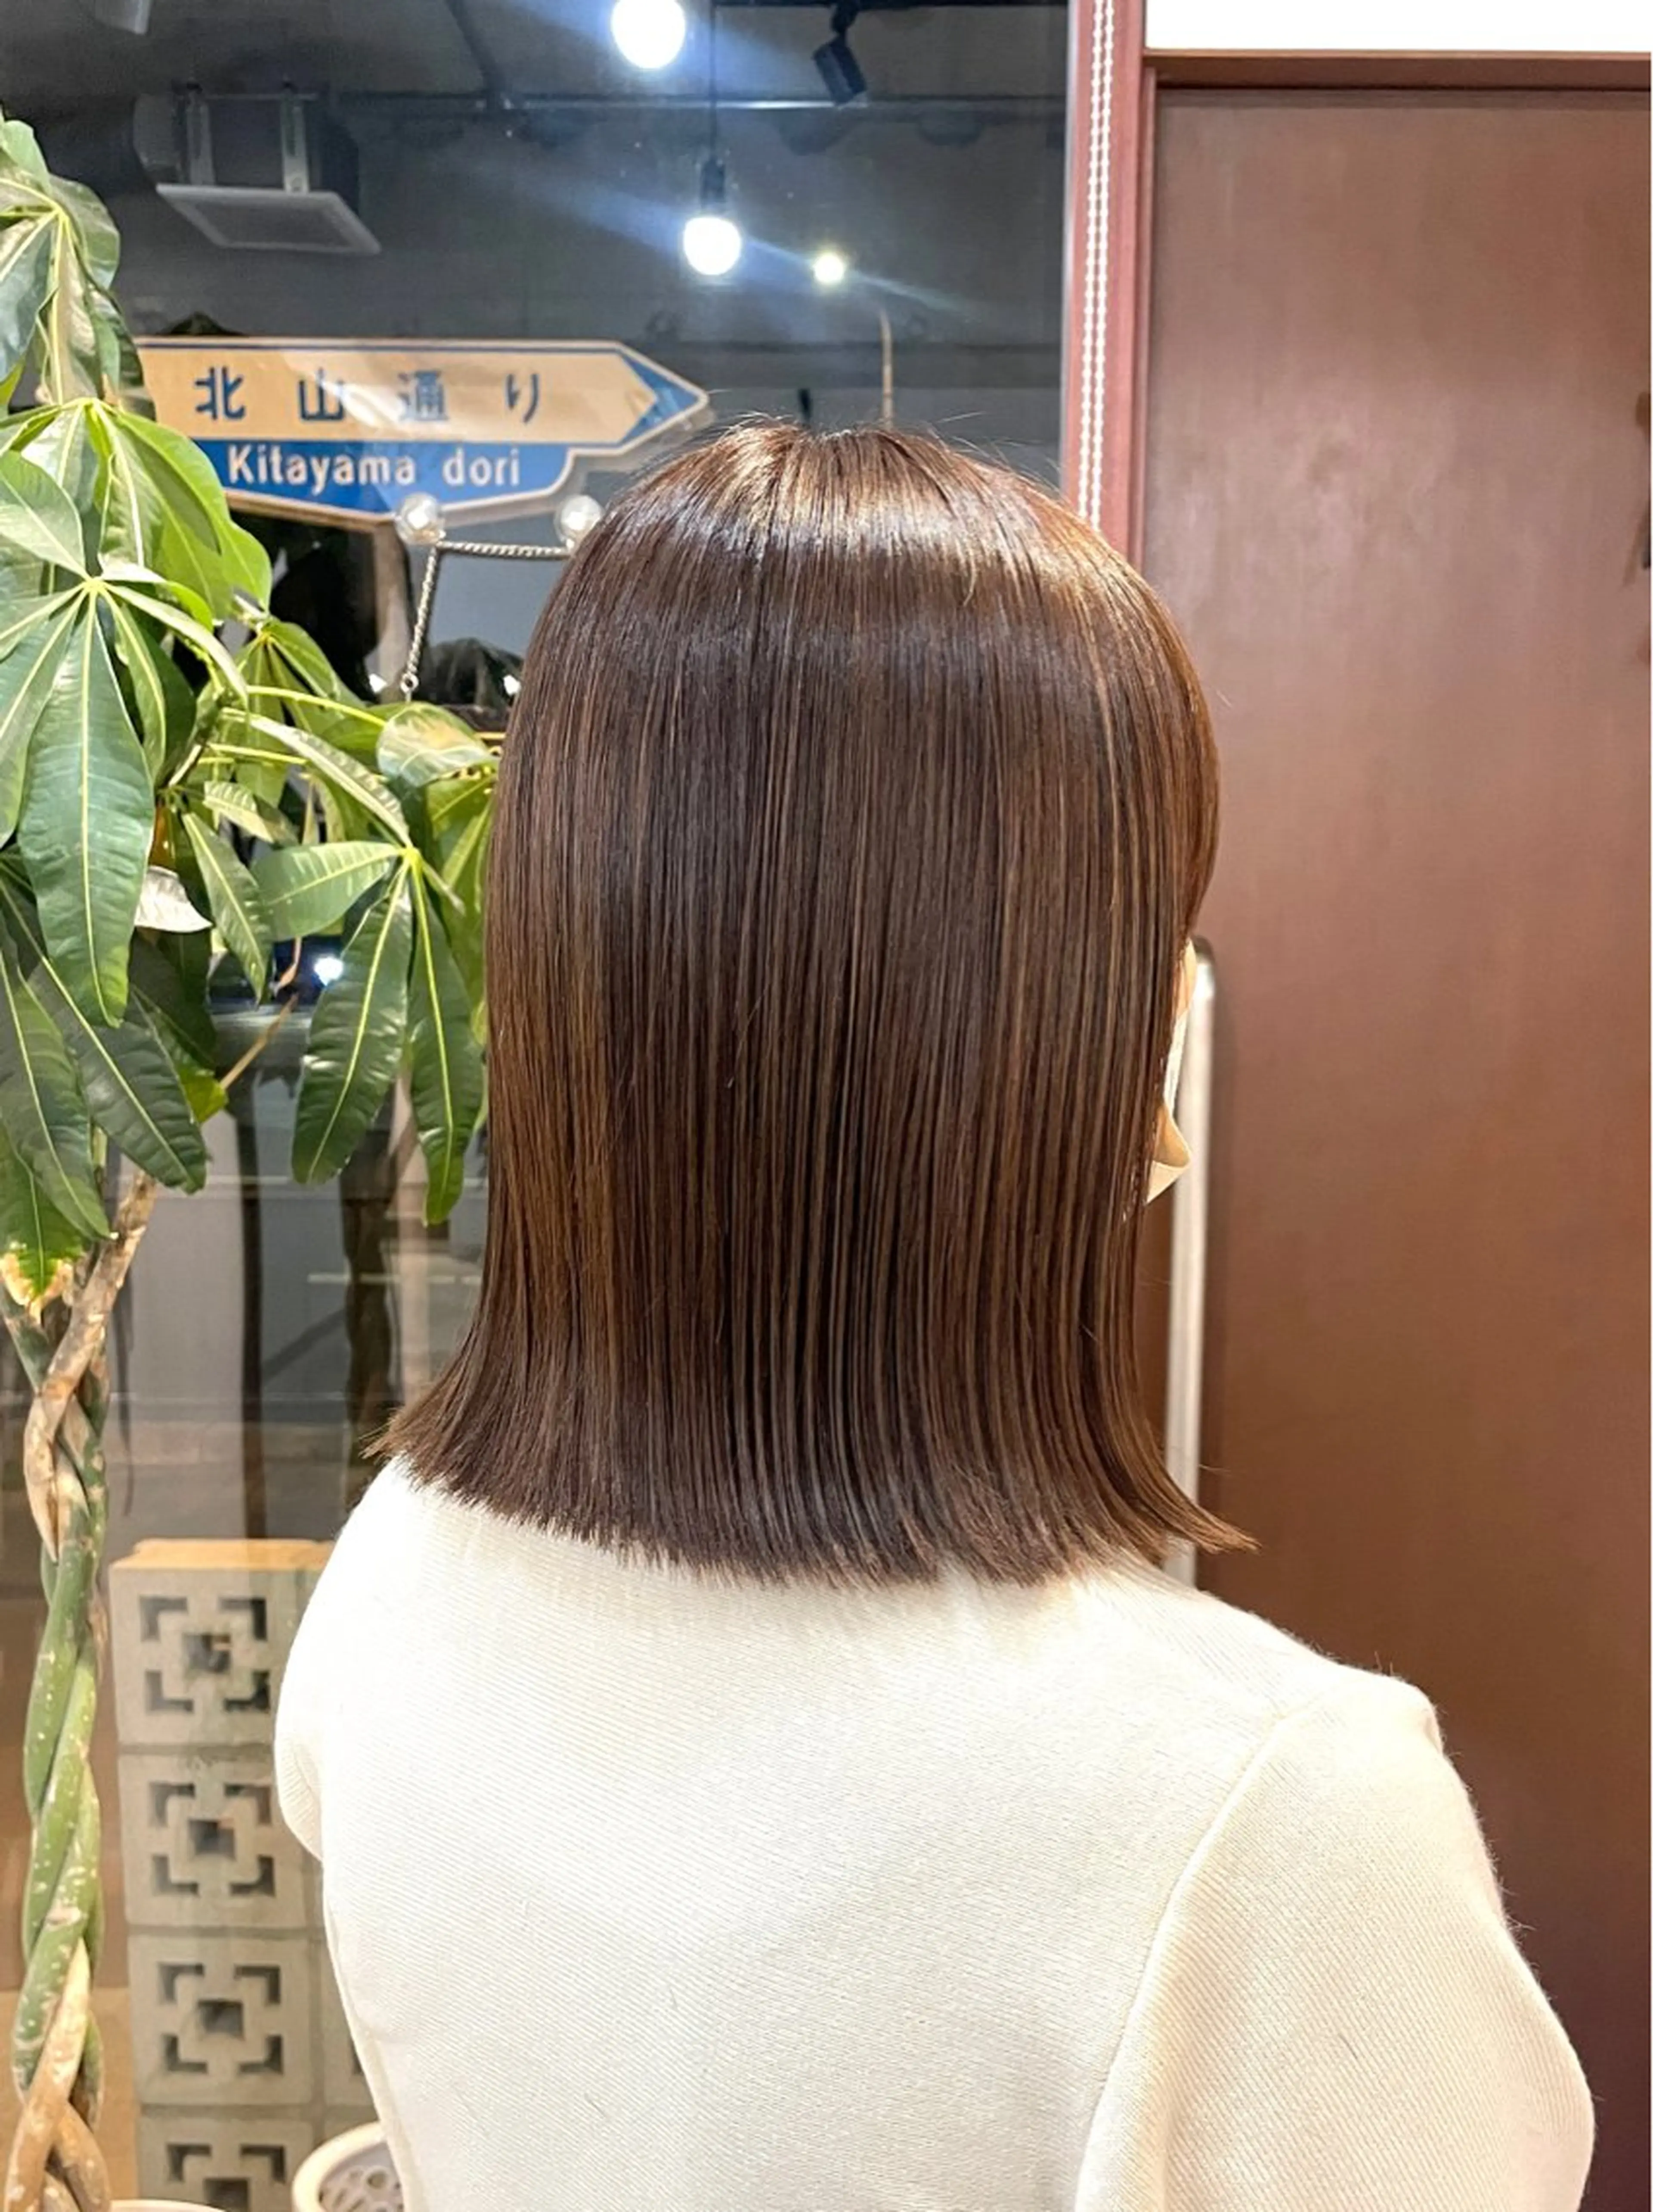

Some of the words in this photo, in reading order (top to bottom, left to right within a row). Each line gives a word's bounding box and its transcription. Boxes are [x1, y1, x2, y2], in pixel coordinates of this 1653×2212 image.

[194, 367, 540, 424] 北山通り
[229, 445, 415, 494] Kitayama
[443, 449, 519, 486] dori
